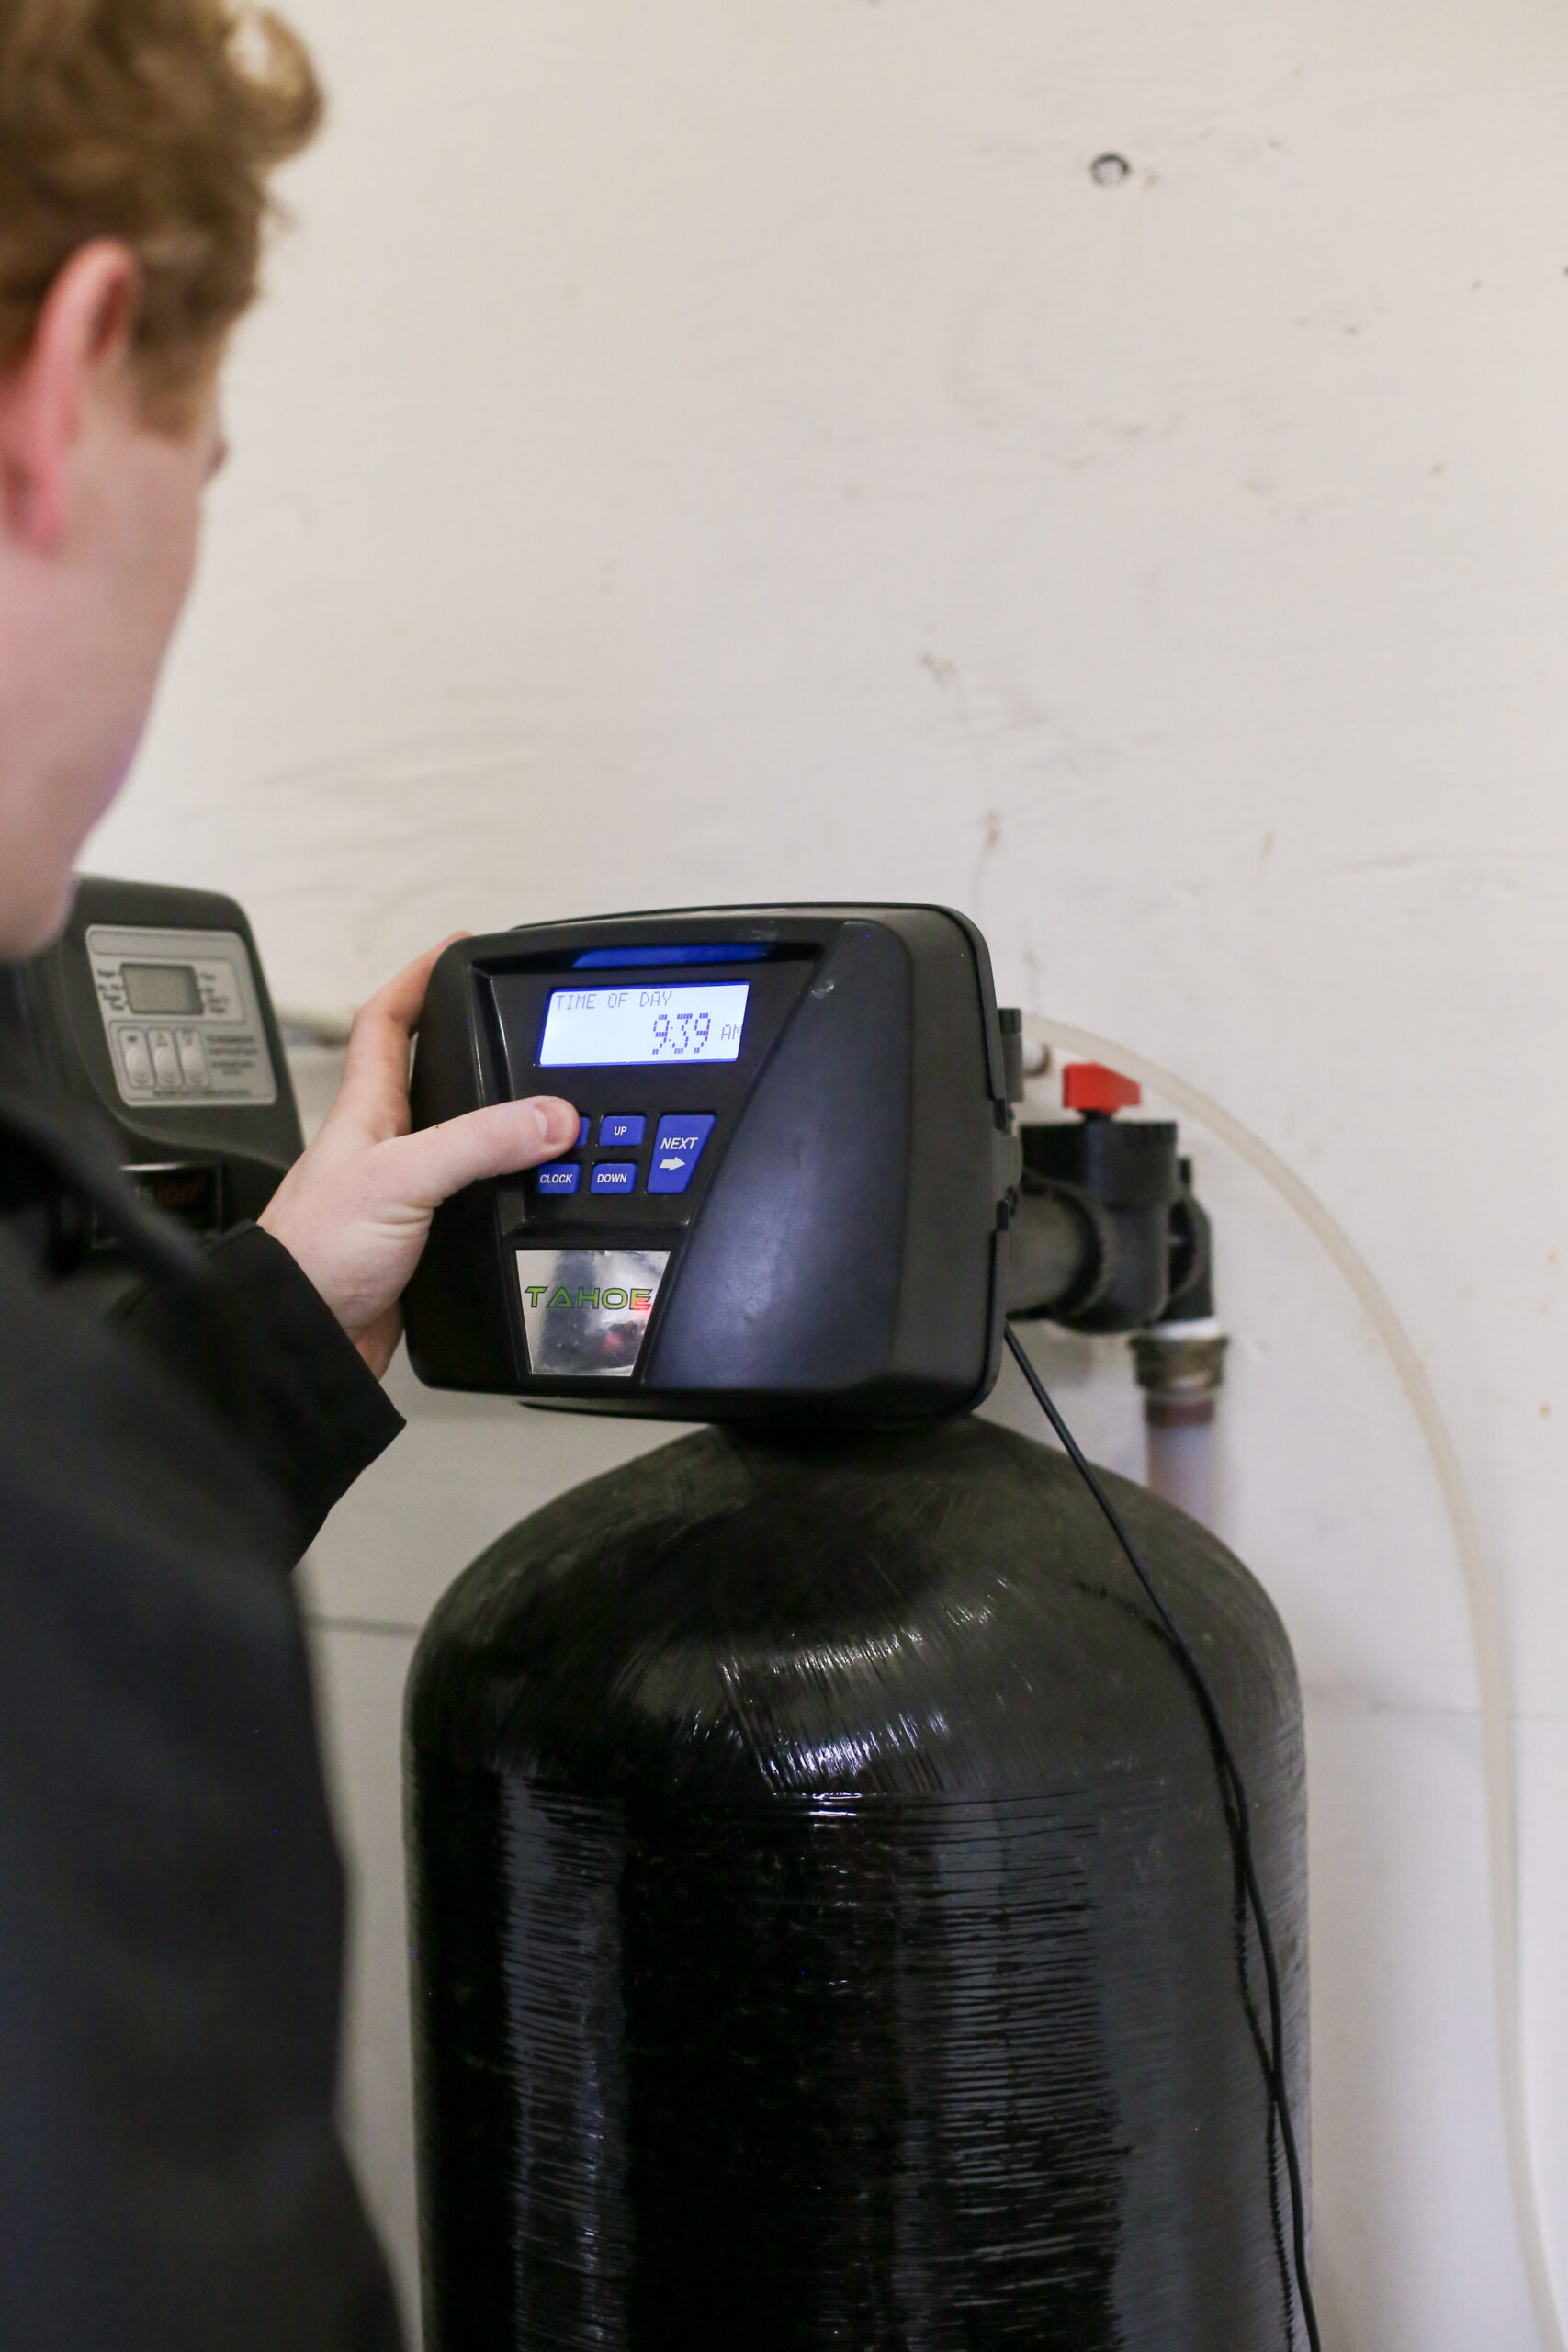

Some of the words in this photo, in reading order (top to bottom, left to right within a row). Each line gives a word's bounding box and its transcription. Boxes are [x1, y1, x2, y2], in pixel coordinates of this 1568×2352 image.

[557, 994, 596, 1010] TIME
[607, 992, 629, 1009] OF
[639, 990, 672, 1007] DAY
[652, 1012, 711, 1055] 9:39
[614, 1125, 627, 1136] UP
[660, 1136, 698, 1150] NEXT
[539, 1173, 573, 1184] CLOCK
[597, 1173, 627, 1183] DOWN
[525, 1286, 653, 1310] TAHOE
